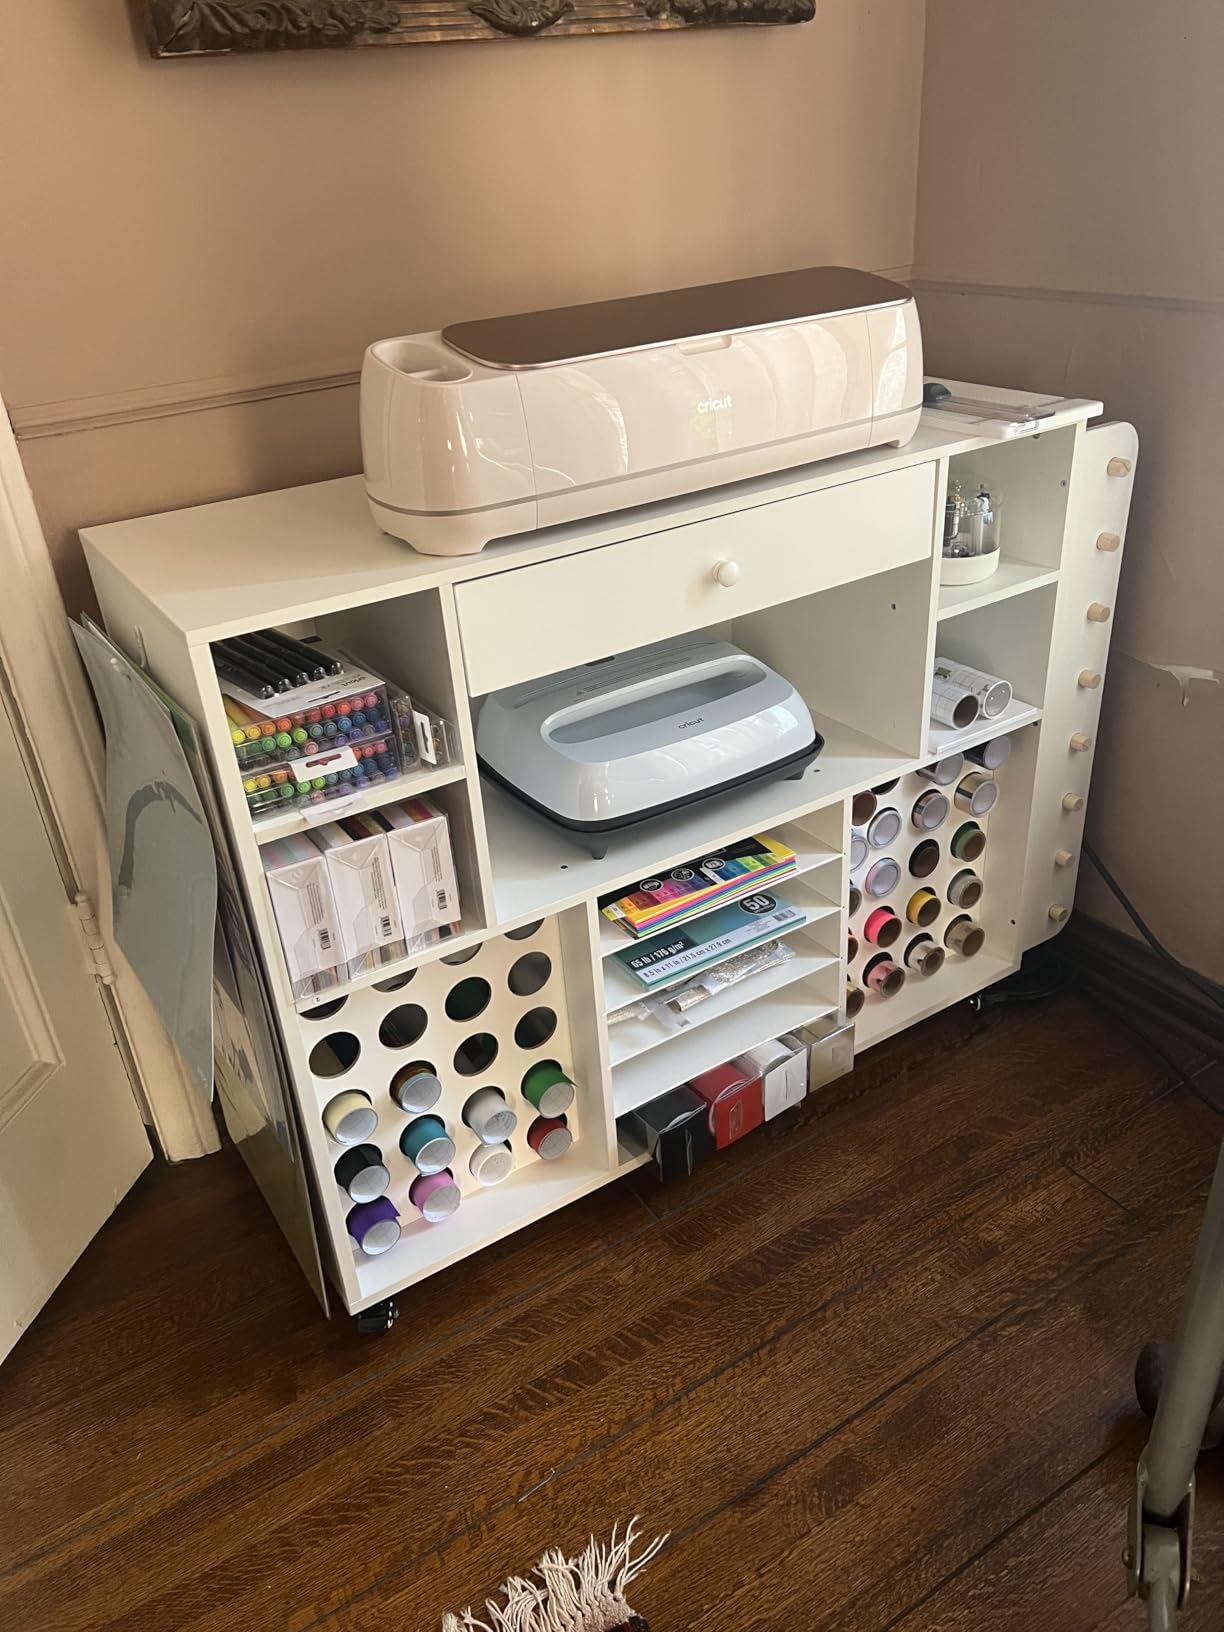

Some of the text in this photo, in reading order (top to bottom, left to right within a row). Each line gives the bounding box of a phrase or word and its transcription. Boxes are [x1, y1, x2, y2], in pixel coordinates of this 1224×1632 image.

[697, 395, 733, 414] cricut
[678, 718, 705, 729] cricut
[742, 895, 770, 911] 50
[630, 959, 644, 969] 65
[641, 956, 652, 964] lb
[653, 948, 670, 959] 176
[696, 948, 706, 956] cm
